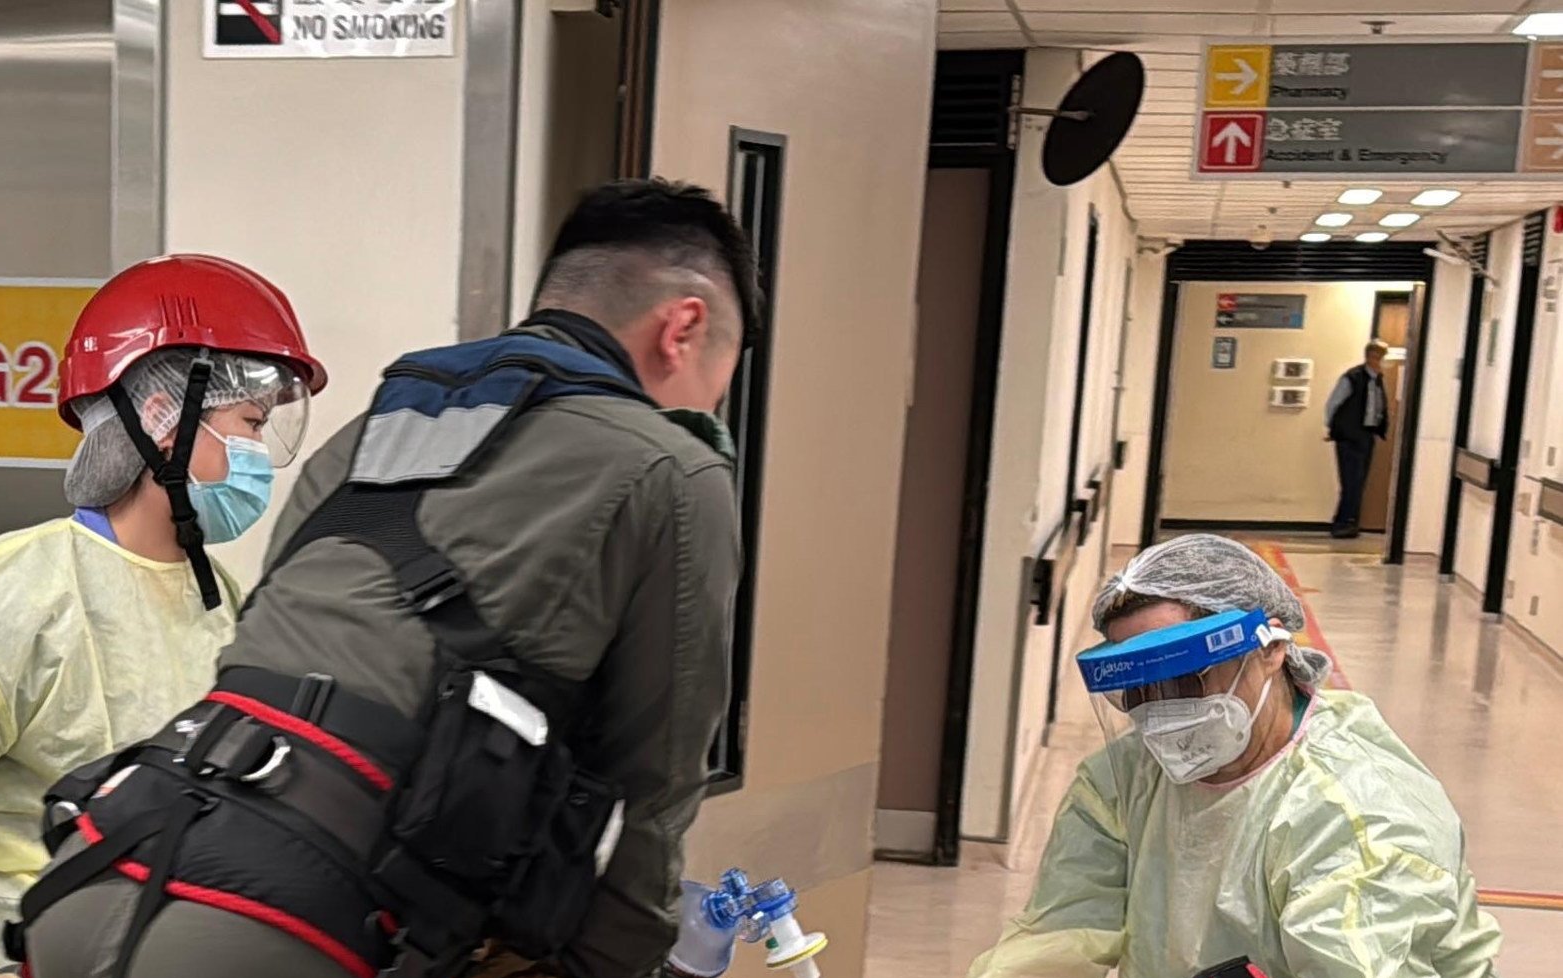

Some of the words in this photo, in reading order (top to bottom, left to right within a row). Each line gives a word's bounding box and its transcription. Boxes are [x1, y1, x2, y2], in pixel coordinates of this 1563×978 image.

[292, 14, 327, 40] NO
[333, 13, 446, 40] SMOKING
[1272, 86, 1347, 101] Pharmacy
[1266, 149, 1335, 161] Accident
[1339, 149, 1350, 161] &
[1358, 149, 1448, 164] Emergency
